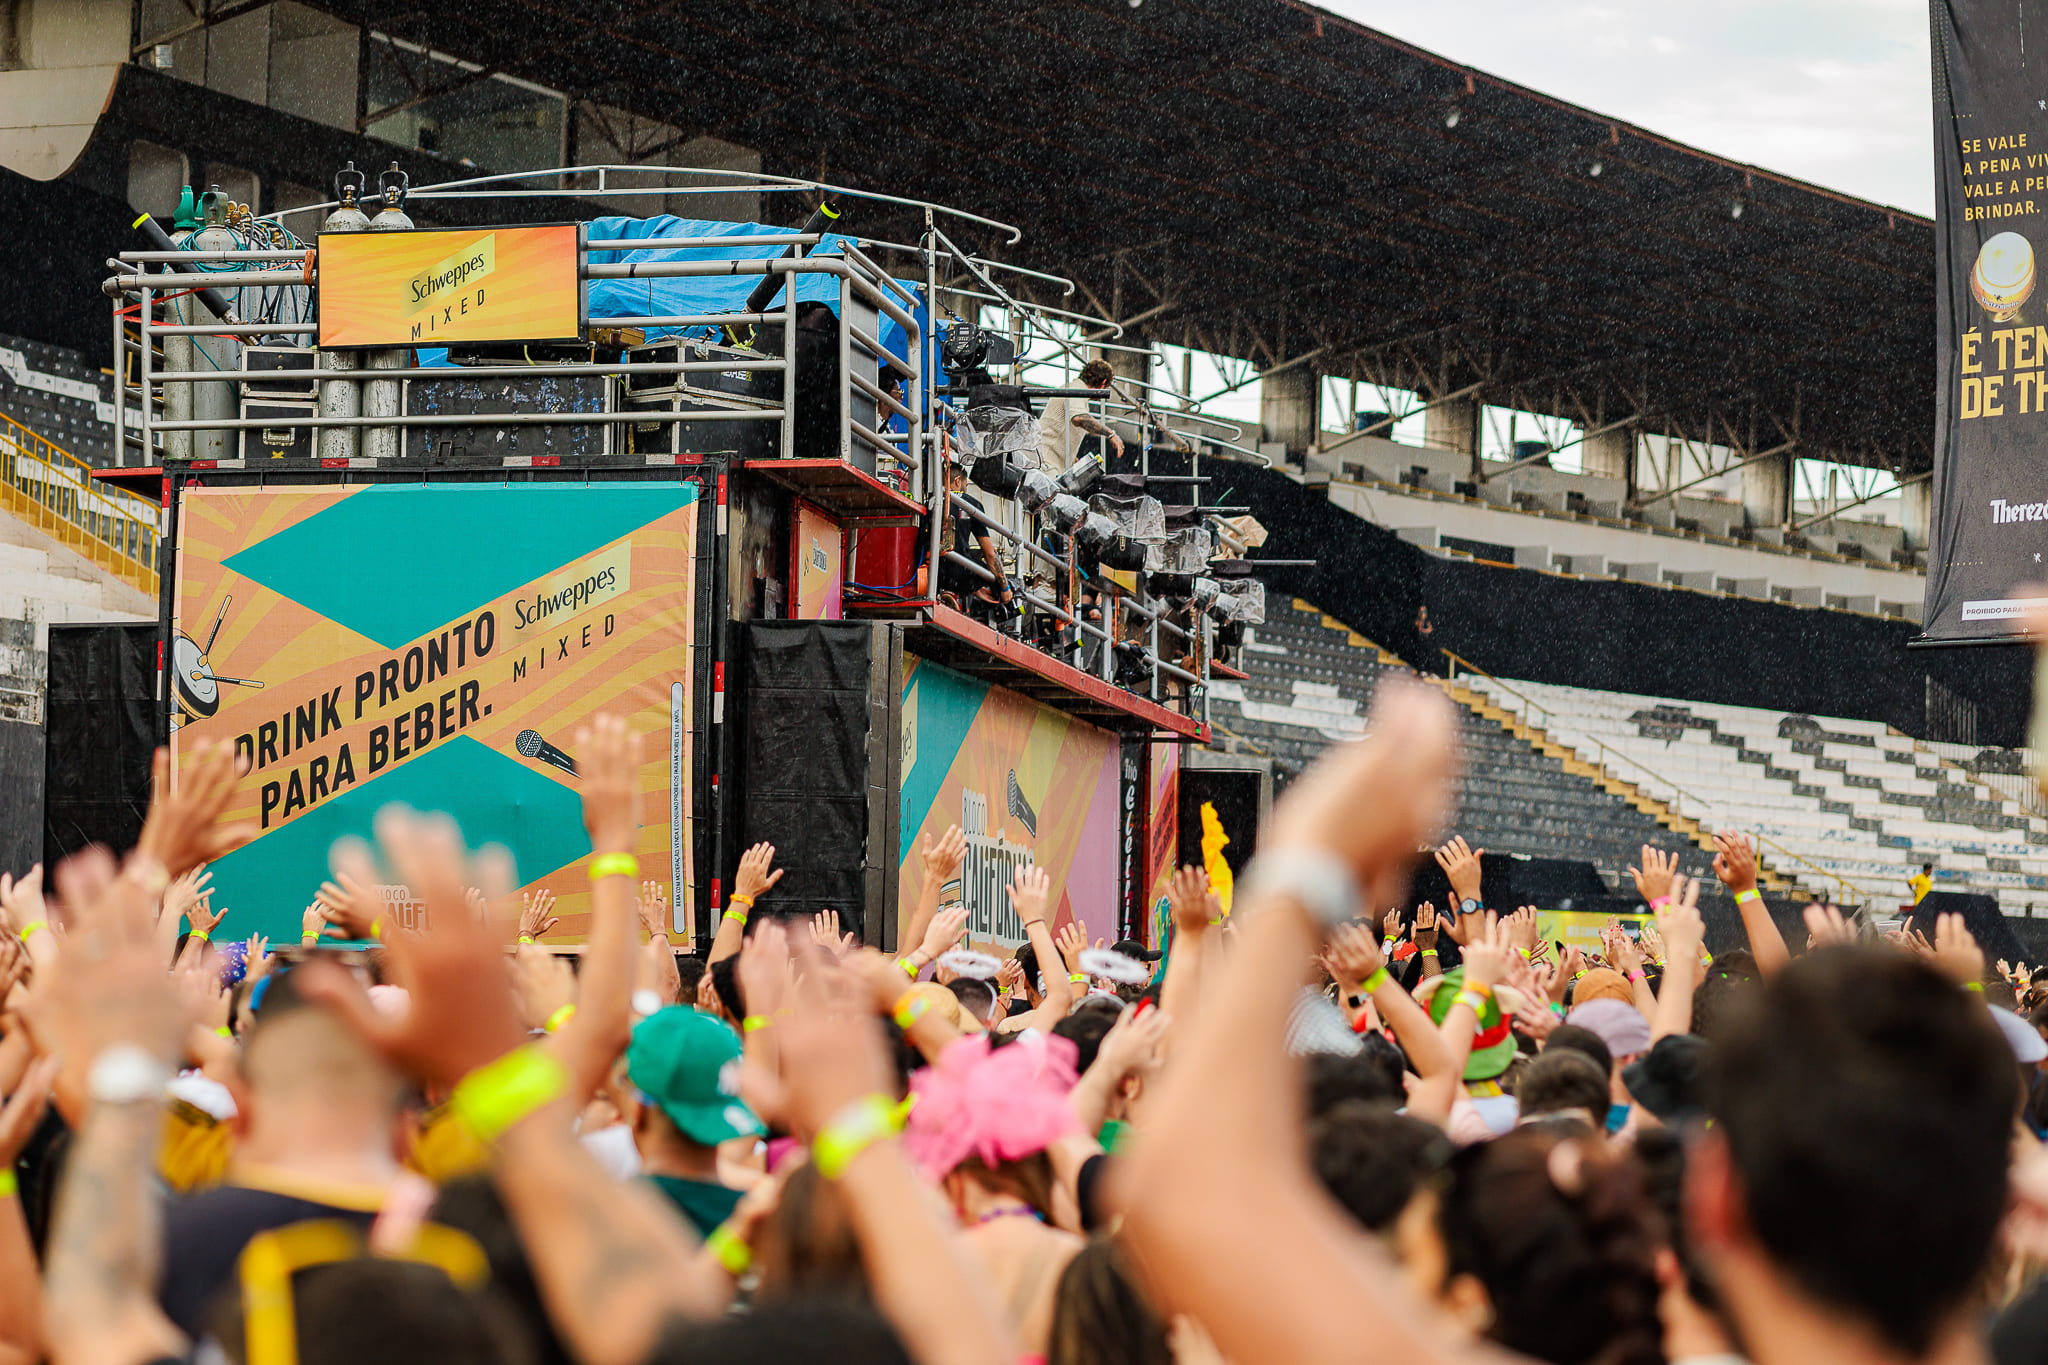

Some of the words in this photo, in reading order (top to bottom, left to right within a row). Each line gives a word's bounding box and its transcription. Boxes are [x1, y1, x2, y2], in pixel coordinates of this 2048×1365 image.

[1962, 139, 1981, 153] SE
[1988, 133, 2027, 151] VALE
[1963, 162, 1973, 176] A
[1980, 157, 2021, 175] PENA
[1964, 181, 2003, 198] VALE
[2009, 180, 2019, 194] A
[2026, 175, 2048, 192] PE
[1965, 200, 2040, 222] BRINDAR.
[412, 254, 485, 303] Schweppes
[411, 289, 485, 342] MIXED
[1961, 326, 1983, 375] É
[1960, 375, 2004, 420] DE
[514, 566, 616, 630] Schweppes
[1966, 607, 2002, 616] PROIBIDO
[513, 614, 615, 683] MIXED
[234, 685, 342, 780] DRINK
[355, 611, 495, 720] PRONTO
[261, 742, 356, 829] PARA
[368, 679, 492, 774] BEBER.
[963, 796, 986, 836] BLOCO
